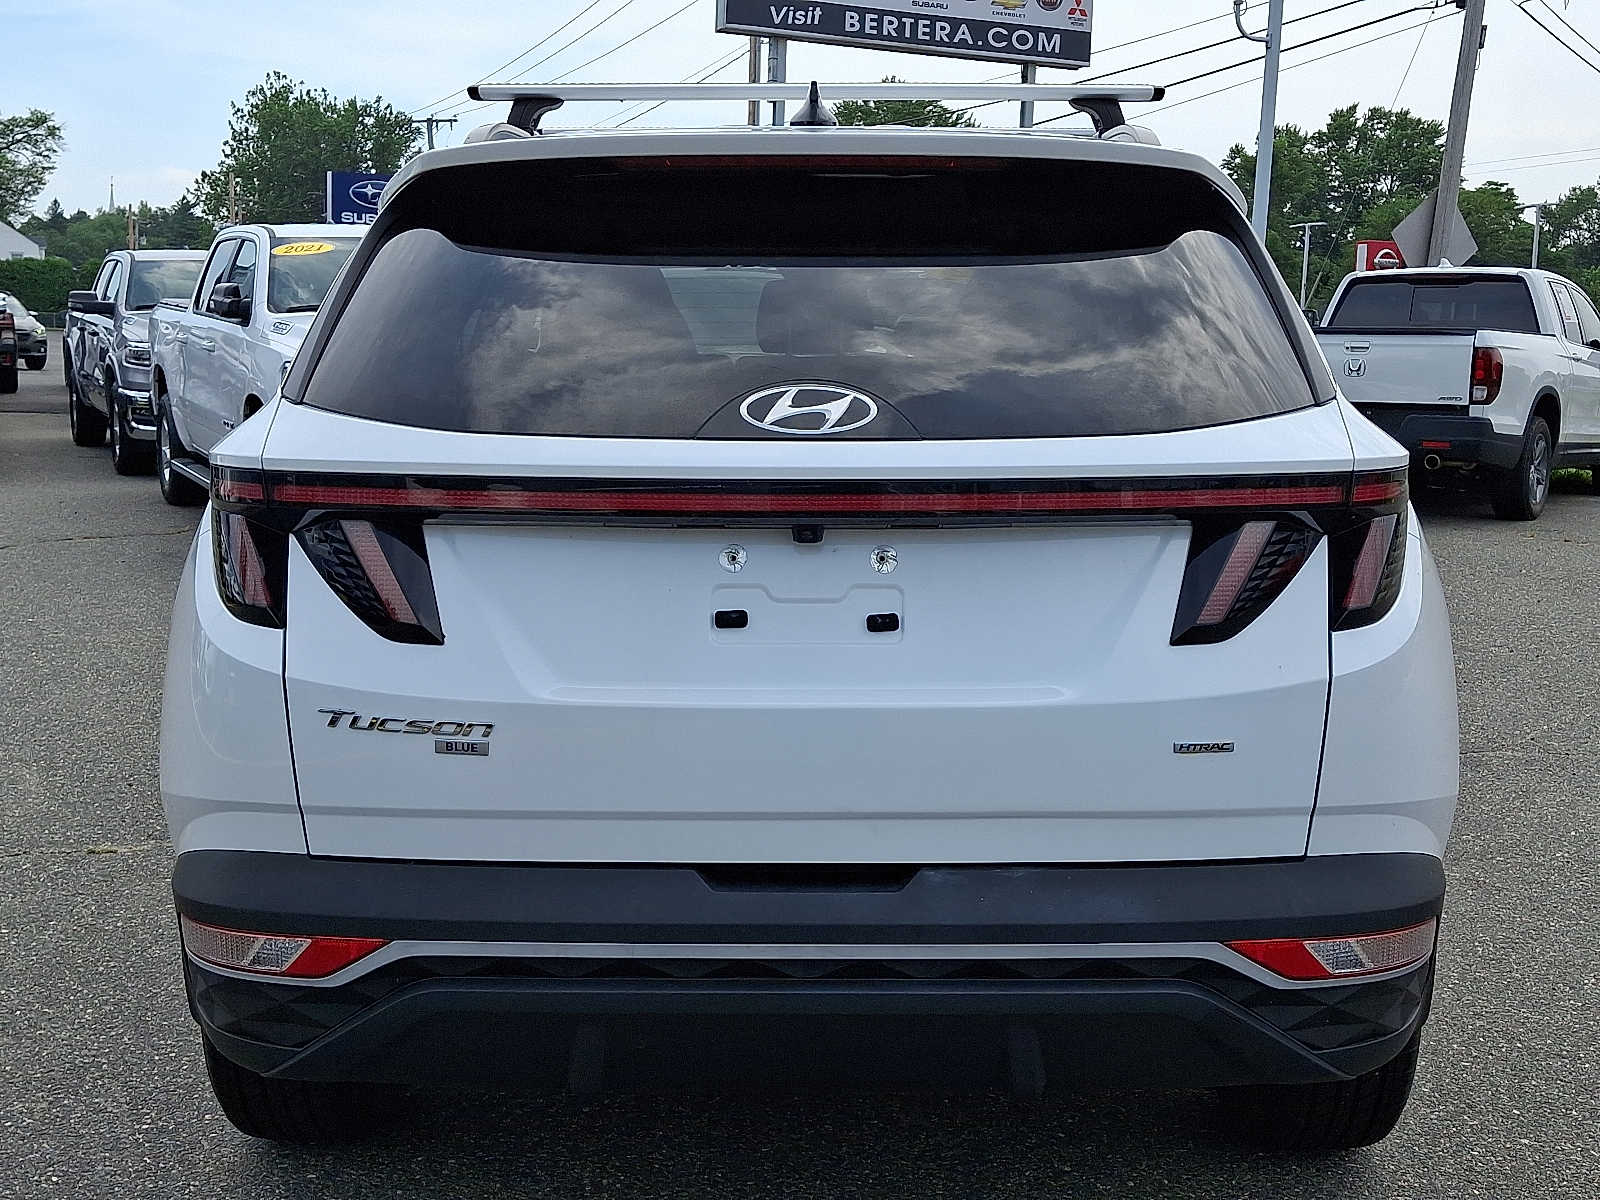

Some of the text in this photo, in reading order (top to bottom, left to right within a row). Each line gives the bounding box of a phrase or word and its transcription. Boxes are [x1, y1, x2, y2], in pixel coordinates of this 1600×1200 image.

[911, 0, 949, 10] SUBARU
[991, 10, 1026, 18] CHEVROLET
[769, 5, 1062, 54] Visit BERTERA.COM
[341, 211, 377, 225] SUB
[282, 244, 324, 254] 2021
[445, 740, 479, 753] BLUE
[1177, 742, 1232, 752] HTRAC
